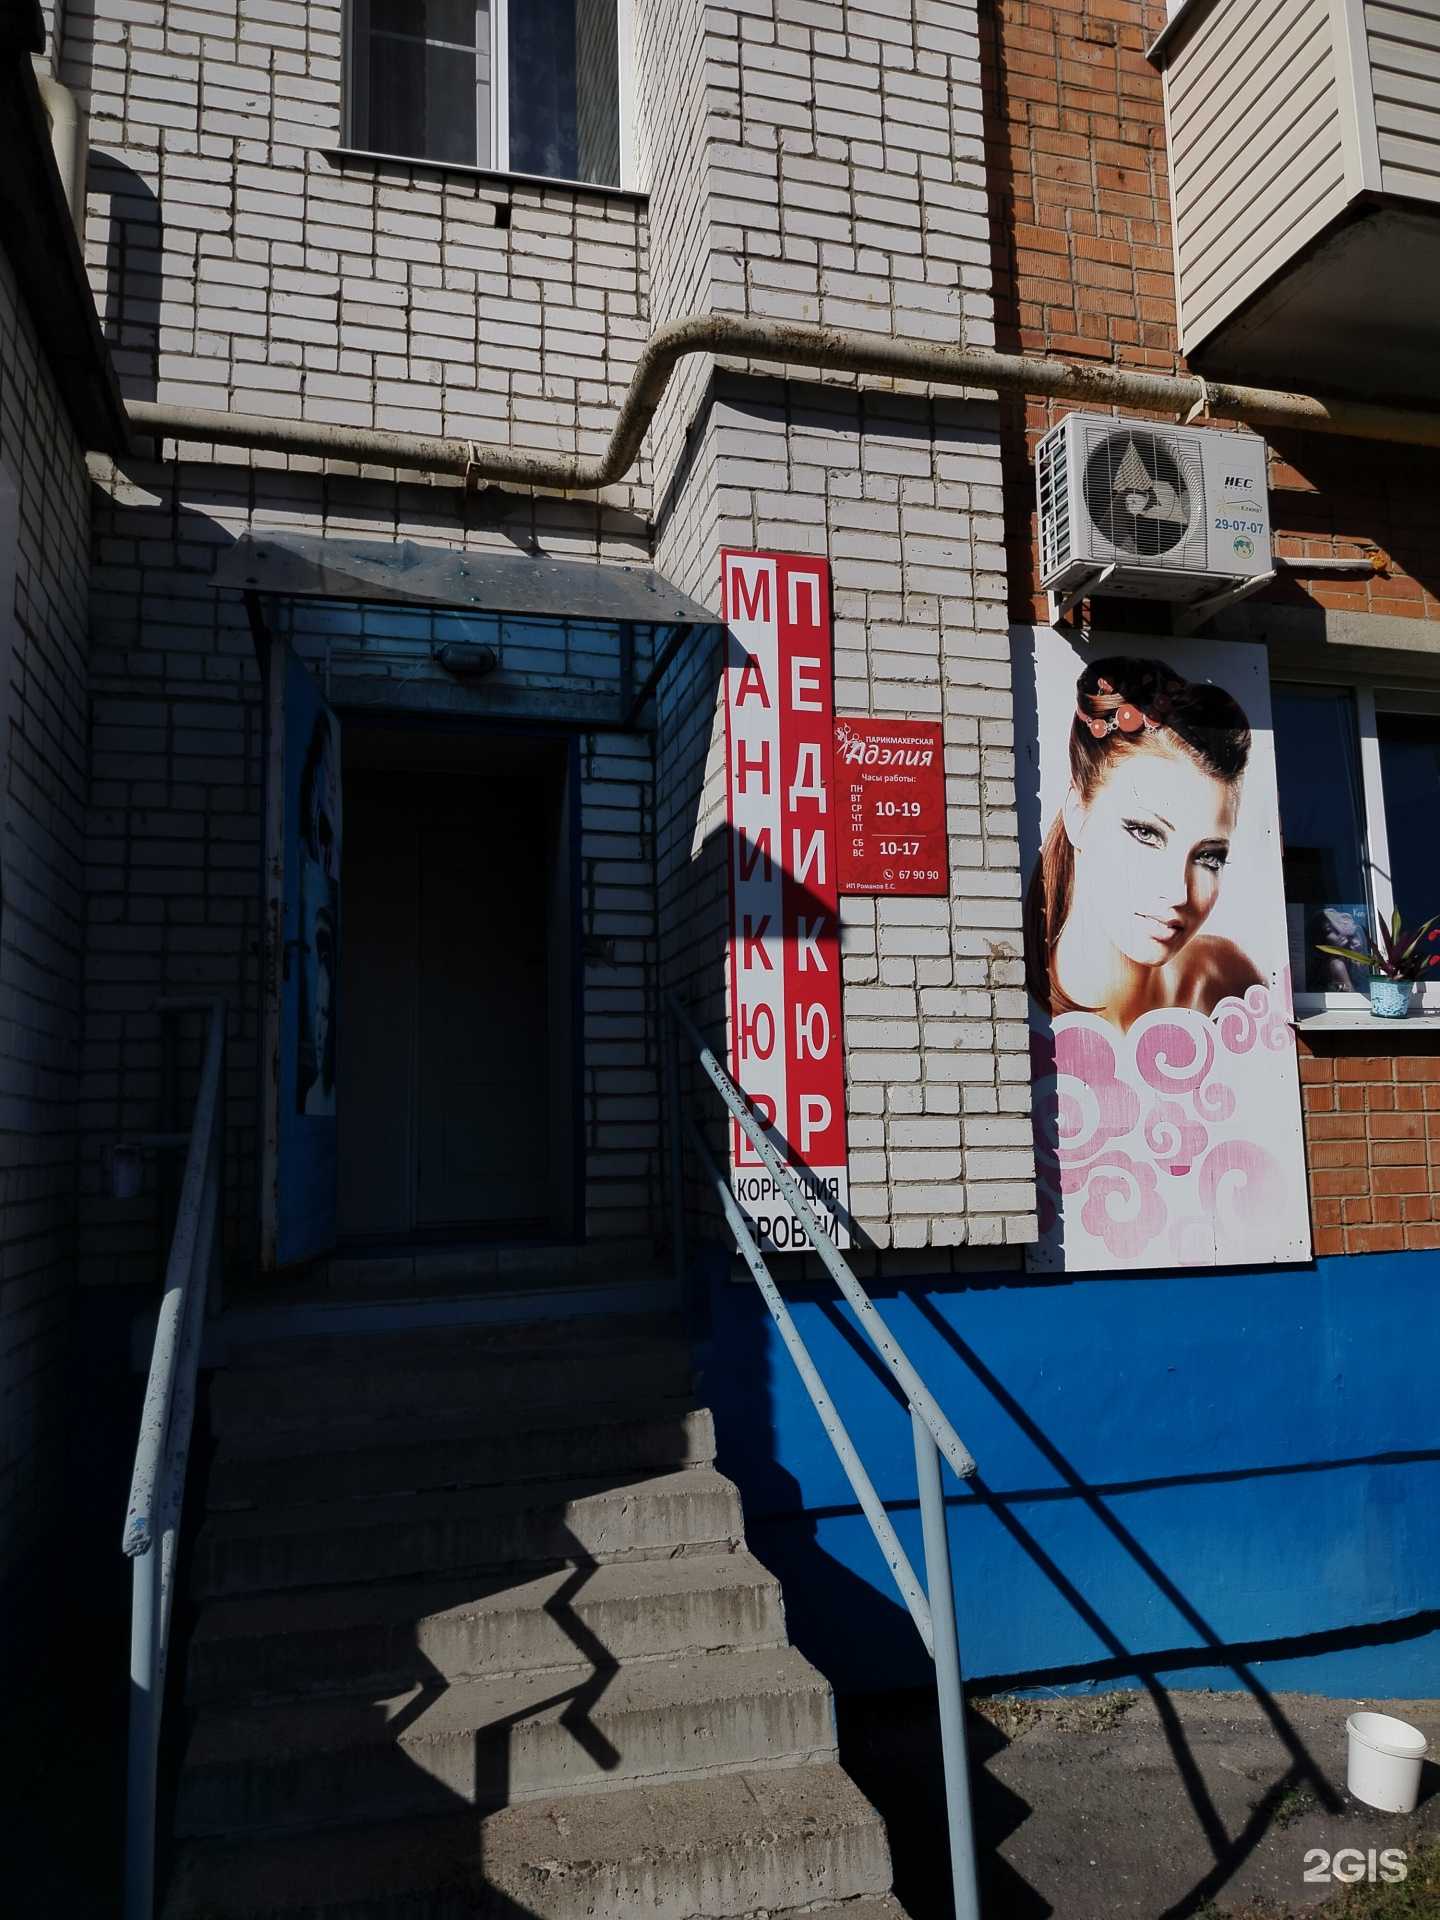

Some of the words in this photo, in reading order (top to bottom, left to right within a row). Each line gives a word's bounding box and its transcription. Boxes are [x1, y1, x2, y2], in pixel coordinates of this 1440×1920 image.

[1224, 476, 1253, 489] HEC
[1215, 518, 1264, 534] 29-07-07
[865, 736, 934, 745] ПАРИКМАХЕРСКАЯ
[845, 740, 934, 767] Адэлия
[862, 773, 883, 782] Часы
[884, 773, 917, 783] работы:
[850, 784, 863, 793] ПН
[851, 794, 862, 802] ВТ
[851, 804, 862, 812] СР
[875, 801, 921, 817] 10-19
[852, 814, 863, 822] ЧТ
[852, 823, 863, 832] ПТ
[852, 838, 864, 847] СБ
[853, 849, 864, 857] ВС
[879, 842, 920, 855] 10-17
[731, 566, 778, 1153] МАНИКЮР
[787, 570, 832, 1153] ПЕДИКЮР
[899, 870, 910, 880] 67
[913, 871, 925, 880] 90
[927, 871, 939, 880] 90
